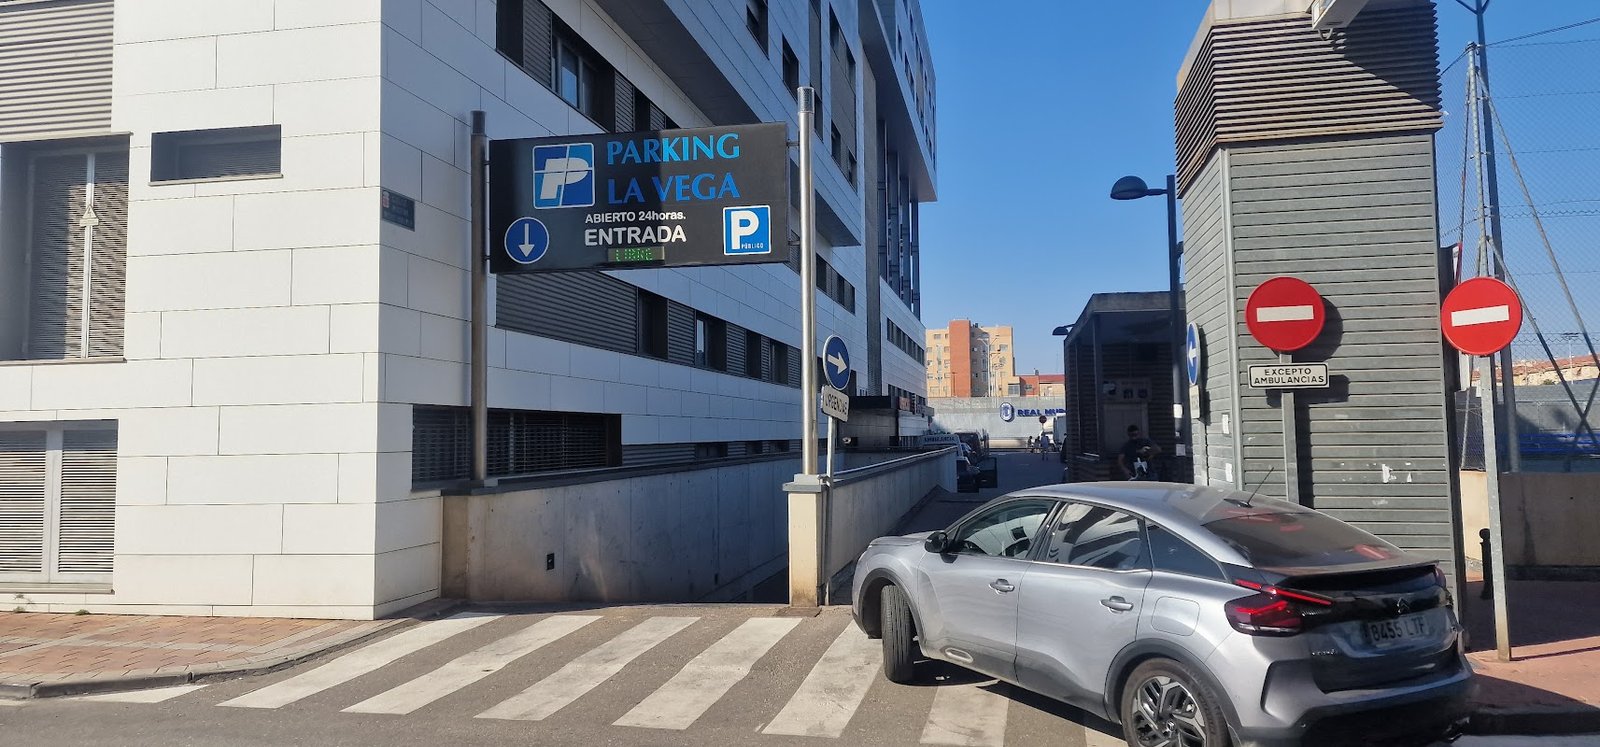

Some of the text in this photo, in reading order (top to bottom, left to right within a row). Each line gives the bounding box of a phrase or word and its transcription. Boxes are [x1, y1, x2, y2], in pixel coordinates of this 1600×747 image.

[607, 133, 740, 165] PARKING
[608, 172, 740, 204] LA VEGA
[585, 211, 687, 224] ABIERTO 24horas.
[584, 224, 687, 246] ENTRADA
[731, 210, 760, 250] P
[1254, 376, 1324, 384] AMBULANCIAS
[1264, 368, 1311, 376] EXCEPTO
[1017, 408, 1041, 416] REAL
[1371, 622, 1402, 641] 8455
